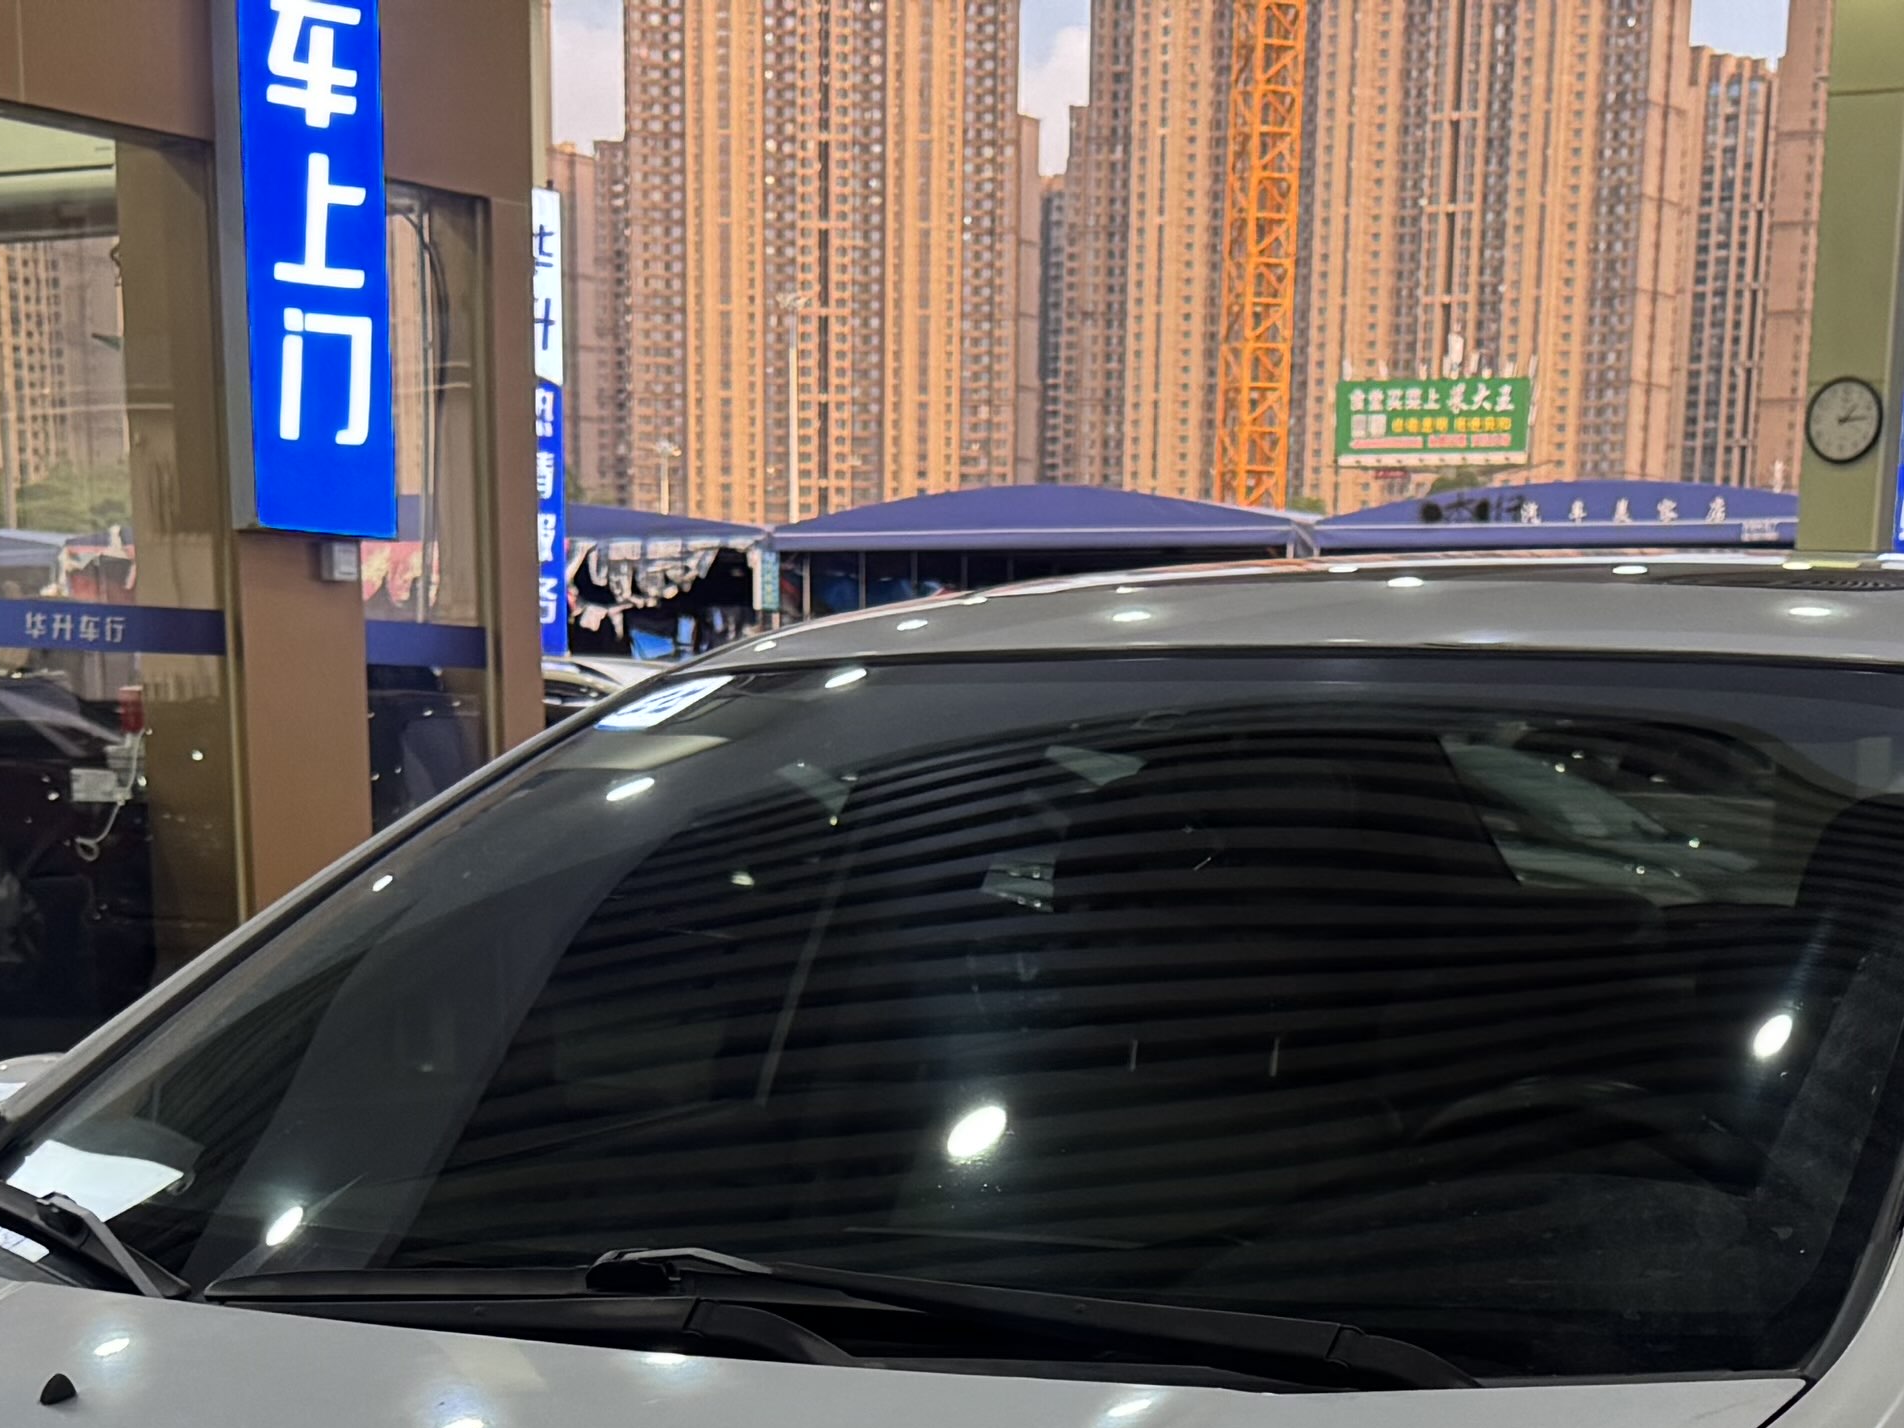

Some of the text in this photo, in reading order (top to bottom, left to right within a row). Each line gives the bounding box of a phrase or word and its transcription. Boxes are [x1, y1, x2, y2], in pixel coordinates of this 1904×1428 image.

[266, 0, 373, 446] 车上门
[24, 610, 127, 645] 华升车行
